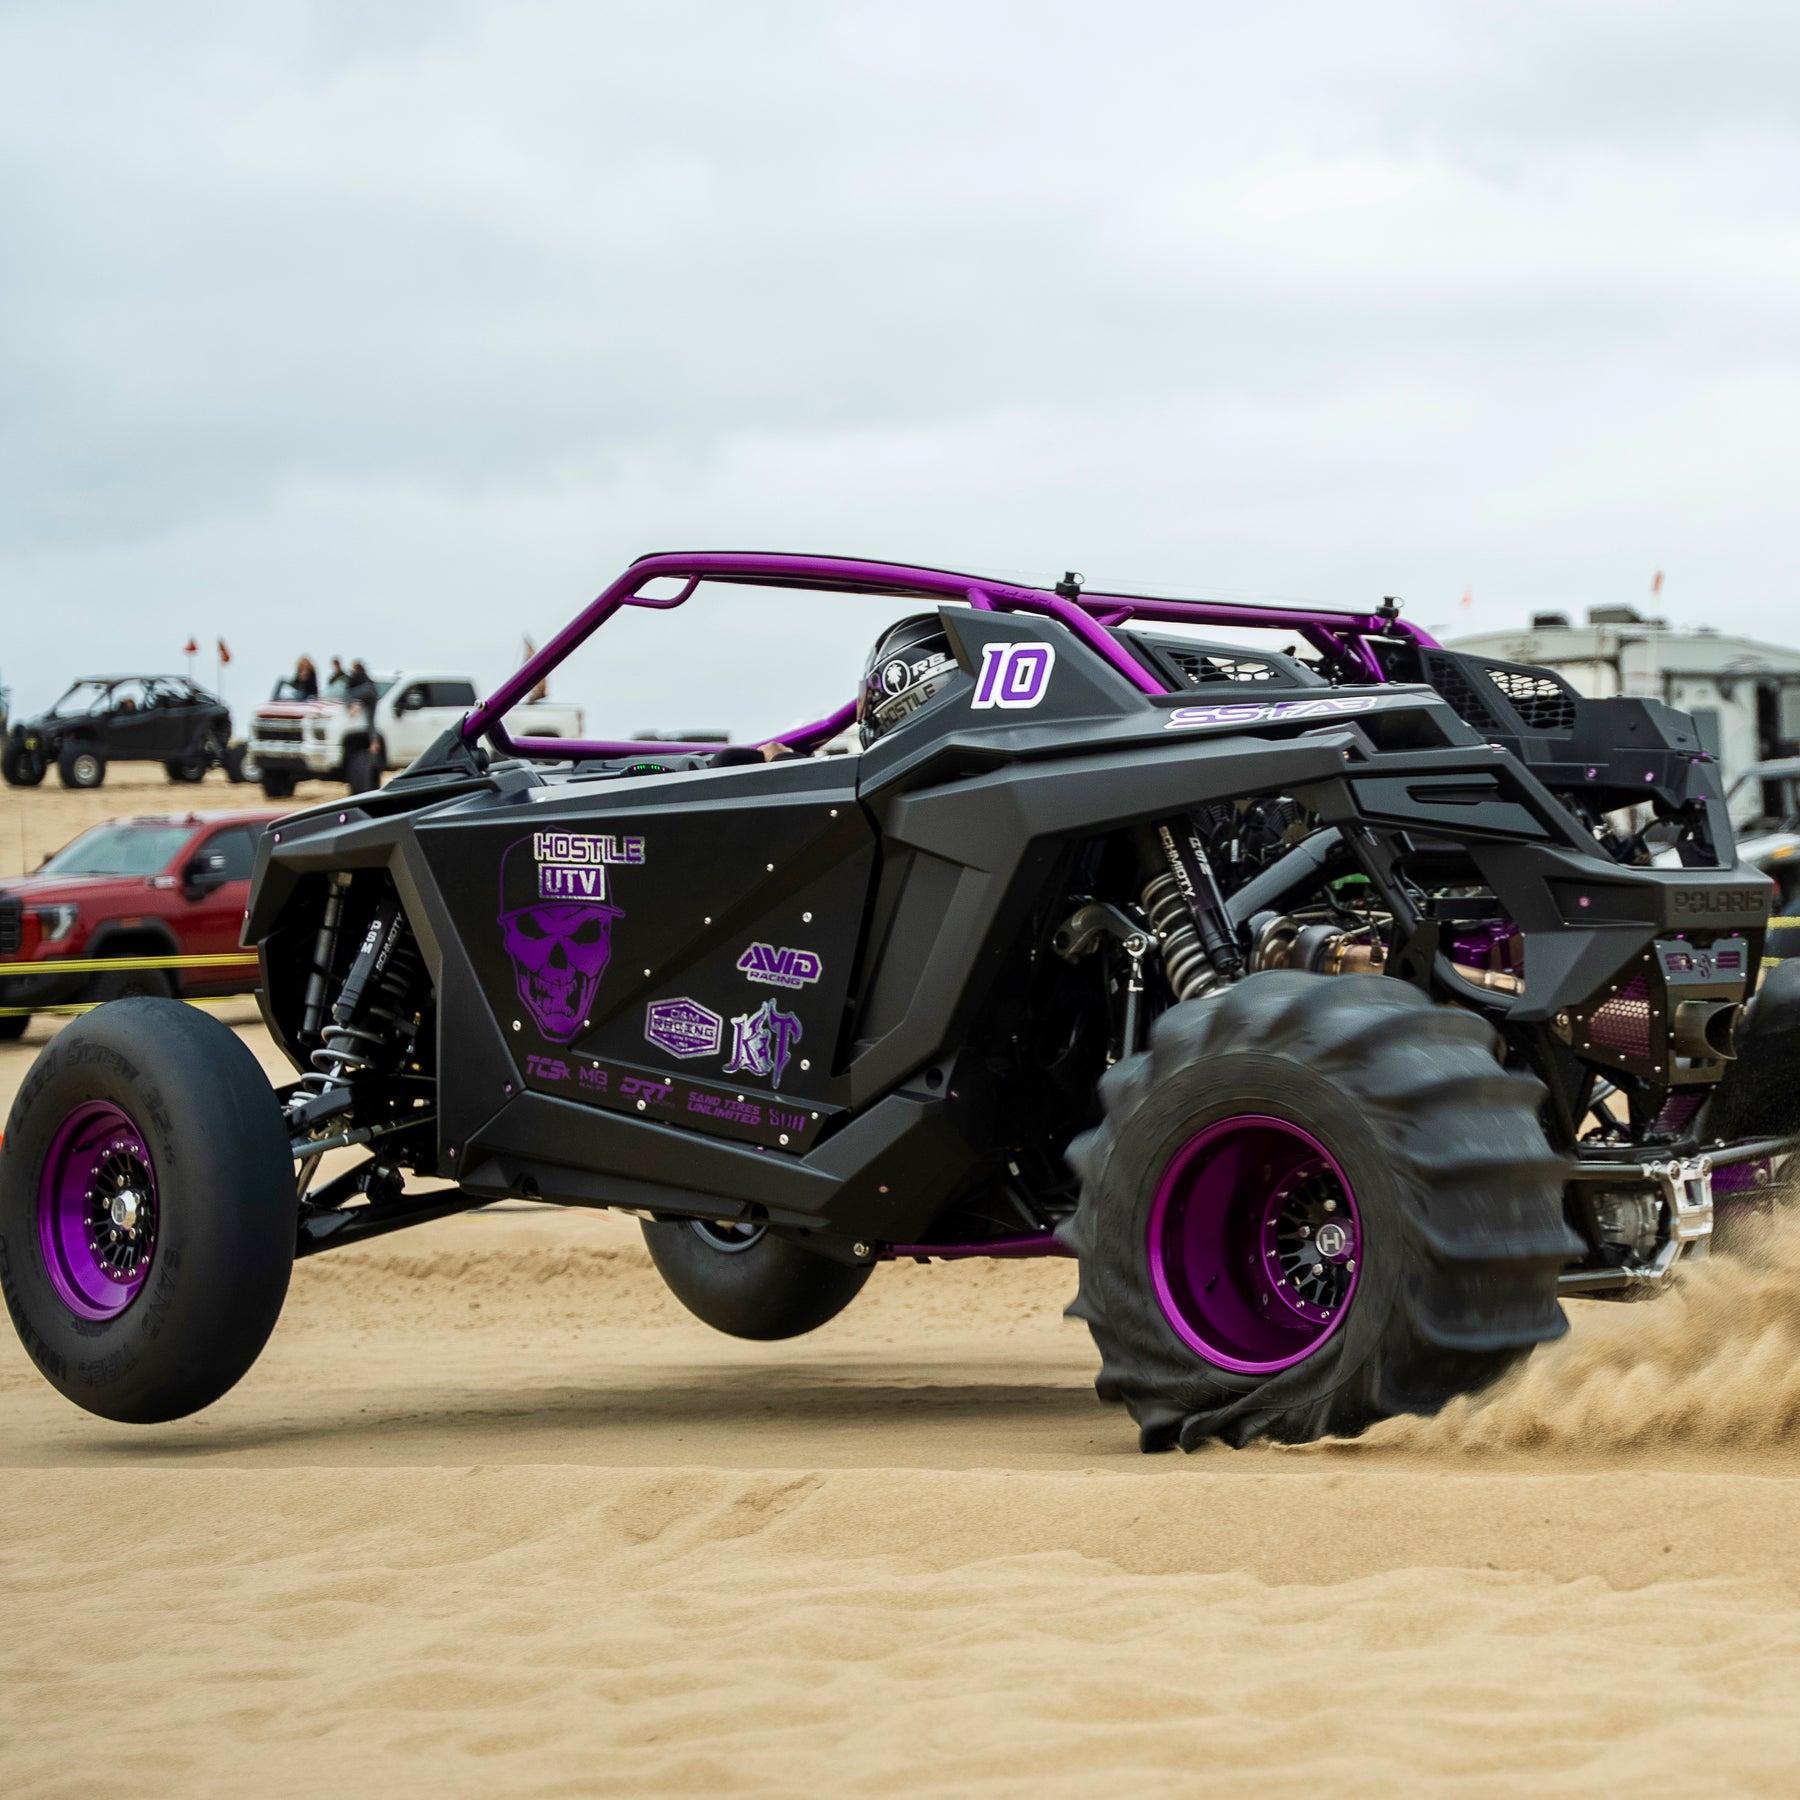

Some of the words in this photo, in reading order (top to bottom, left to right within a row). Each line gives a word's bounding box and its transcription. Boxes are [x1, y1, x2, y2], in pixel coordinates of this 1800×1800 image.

[971, 642, 1055, 709] 10
[880, 683, 936, 727] HOSTILE
[533, 832, 645, 864] HOSTILE
[545, 868, 597, 895] UTV
[1674, 889, 1765, 913] POLARIS
[361, 920, 382, 954] PSM
[737, 942, 822, 979] AVID
[749, 970, 803, 987] RACING
[654, 1018, 714, 1039] RACING
[688, 1091, 722, 1107] SAND
[723, 1099, 762, 1116] TIRES
[688, 1102, 761, 1126] UNLIMITED
[1321, 1232, 1341, 1252] H
